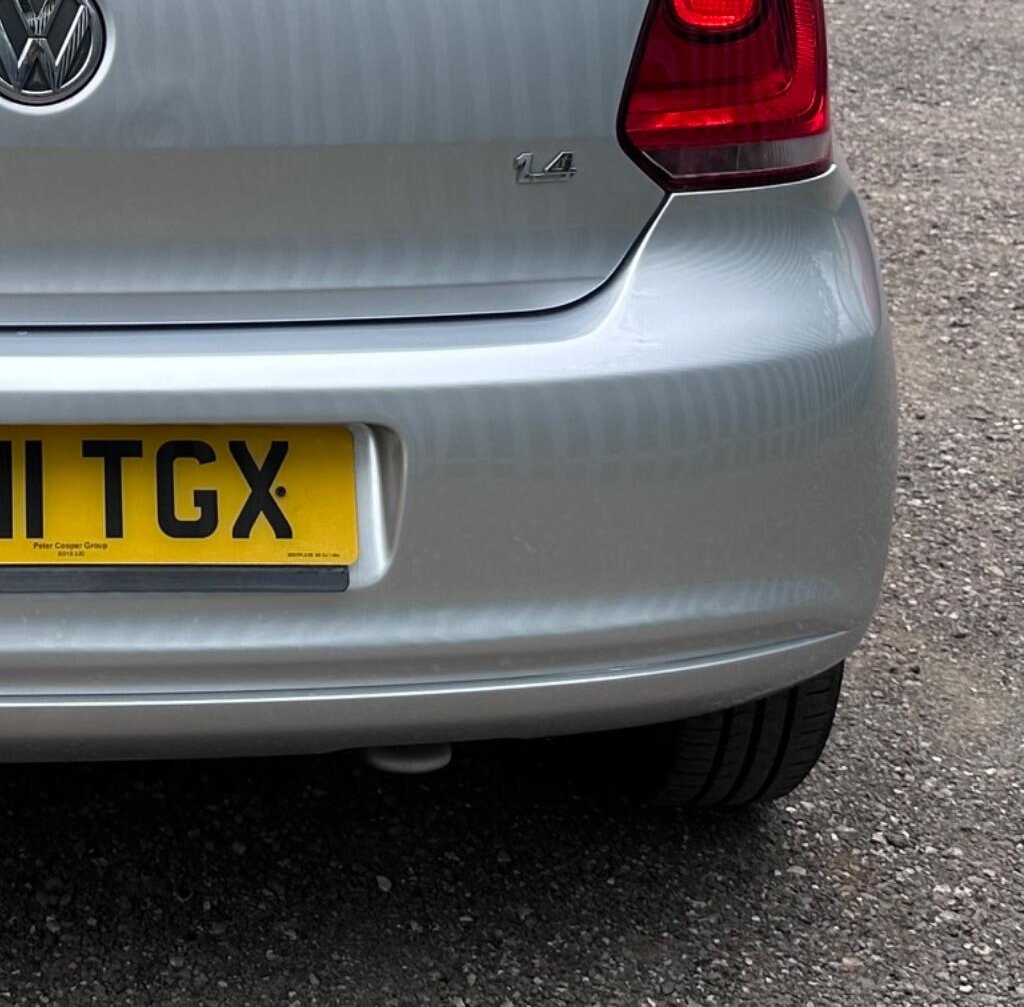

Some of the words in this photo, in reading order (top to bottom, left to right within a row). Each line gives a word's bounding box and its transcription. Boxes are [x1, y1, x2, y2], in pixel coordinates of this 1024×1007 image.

[514, 151, 578, 185] 1.4
[81, 439, 294, 540] TGX
[33, 542, 53, 550] Peter
[55, 542, 83, 551] Cooper
[84, 541, 108, 551] Group
